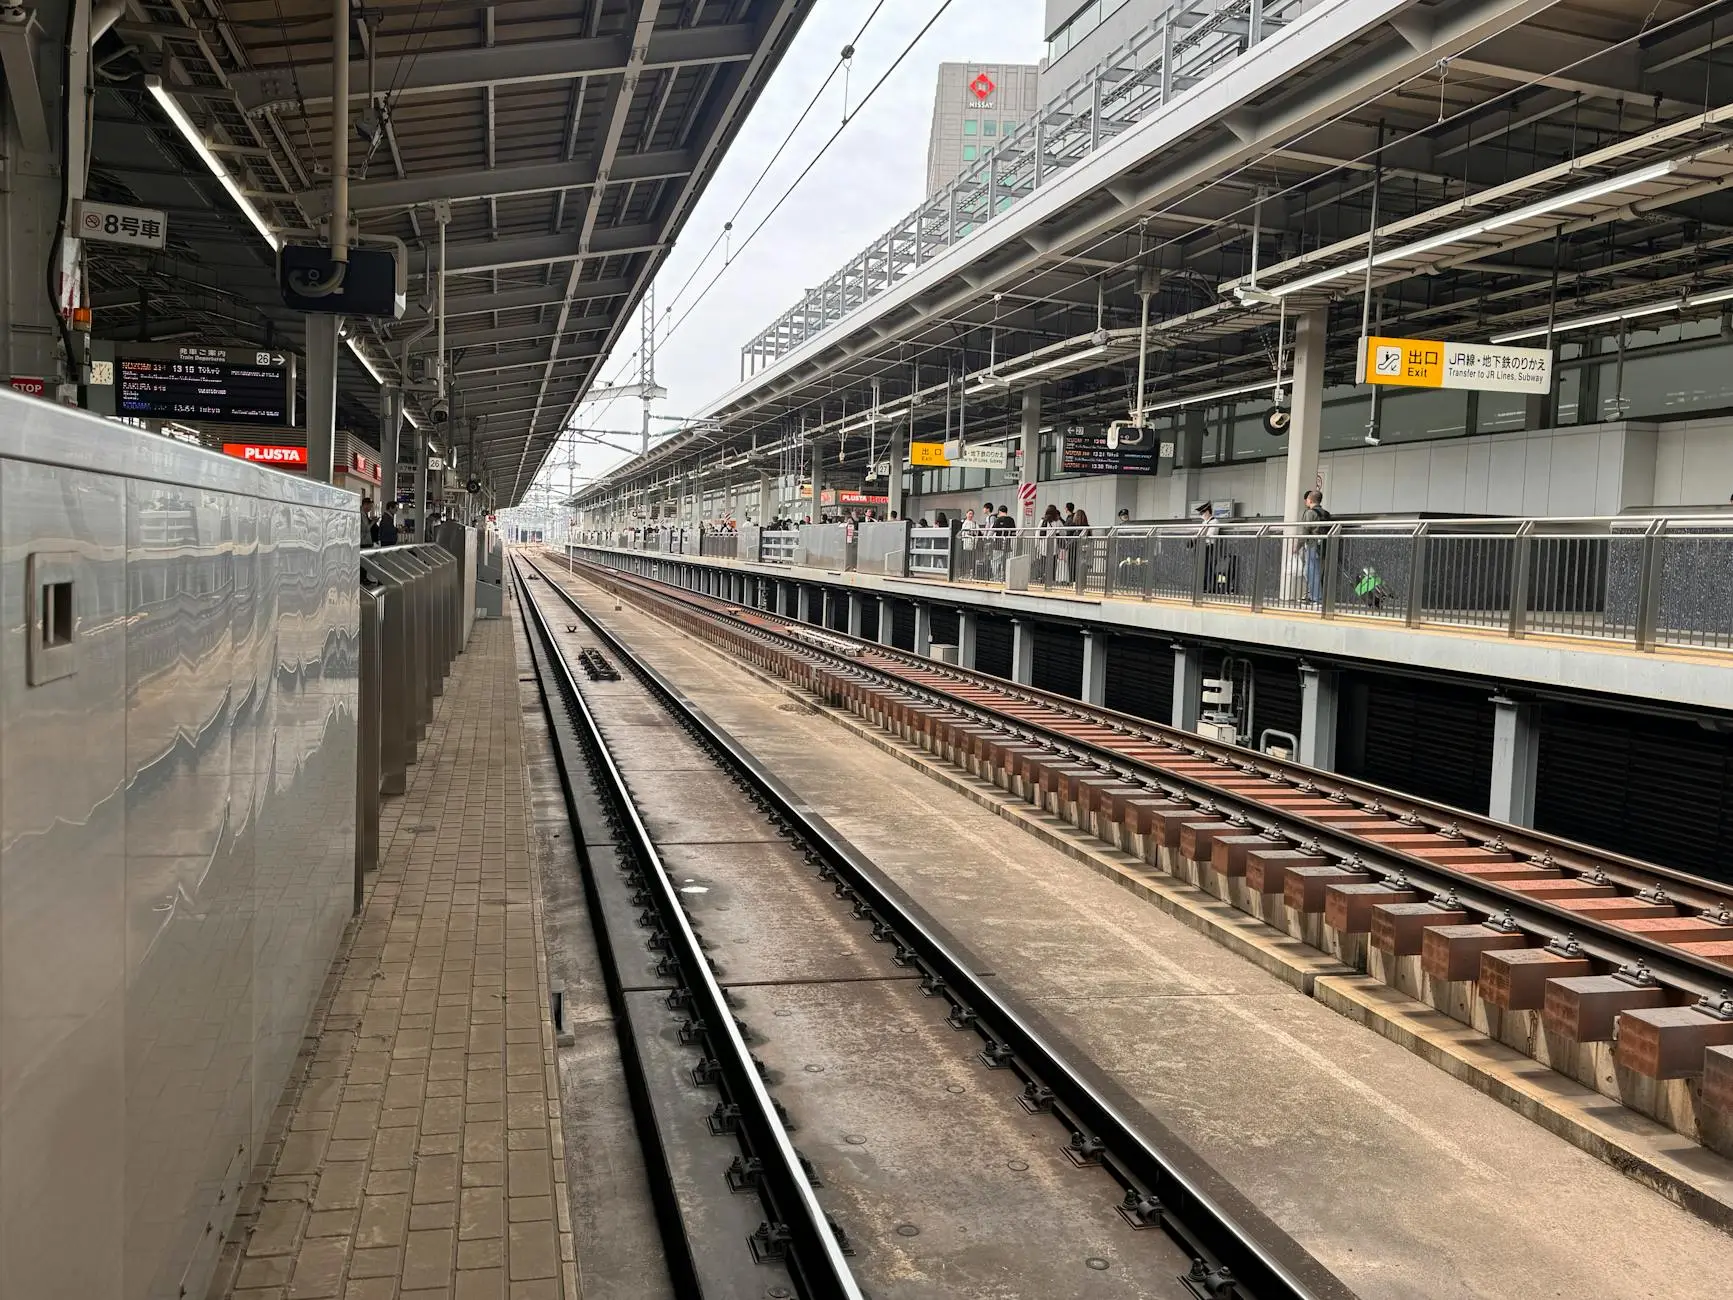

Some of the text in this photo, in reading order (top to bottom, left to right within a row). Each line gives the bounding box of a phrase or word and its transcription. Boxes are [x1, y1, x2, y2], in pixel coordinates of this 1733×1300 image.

[104, 214, 160, 239] 8号車
[258, 353, 269, 364] 26
[1408, 350, 1438, 365] 出口
[1449, 353, 1546, 371] JR線・地下鉄のりかえ
[1407, 368, 1427, 378] Exit
[1449, 368, 1476, 378] Transfer
[1478, 370, 1484, 378] to
[1486, 370, 1495, 379] JR
[1518, 372, 1544, 384] Subway
[12, 383, 42, 393] STOP
[244, 447, 300, 461] PLUSTA
[921, 448, 942, 456] 出口
[430, 459, 440, 468] 26
[879, 465, 888, 473] 27
[842, 494, 868, 503] PLUSTA
